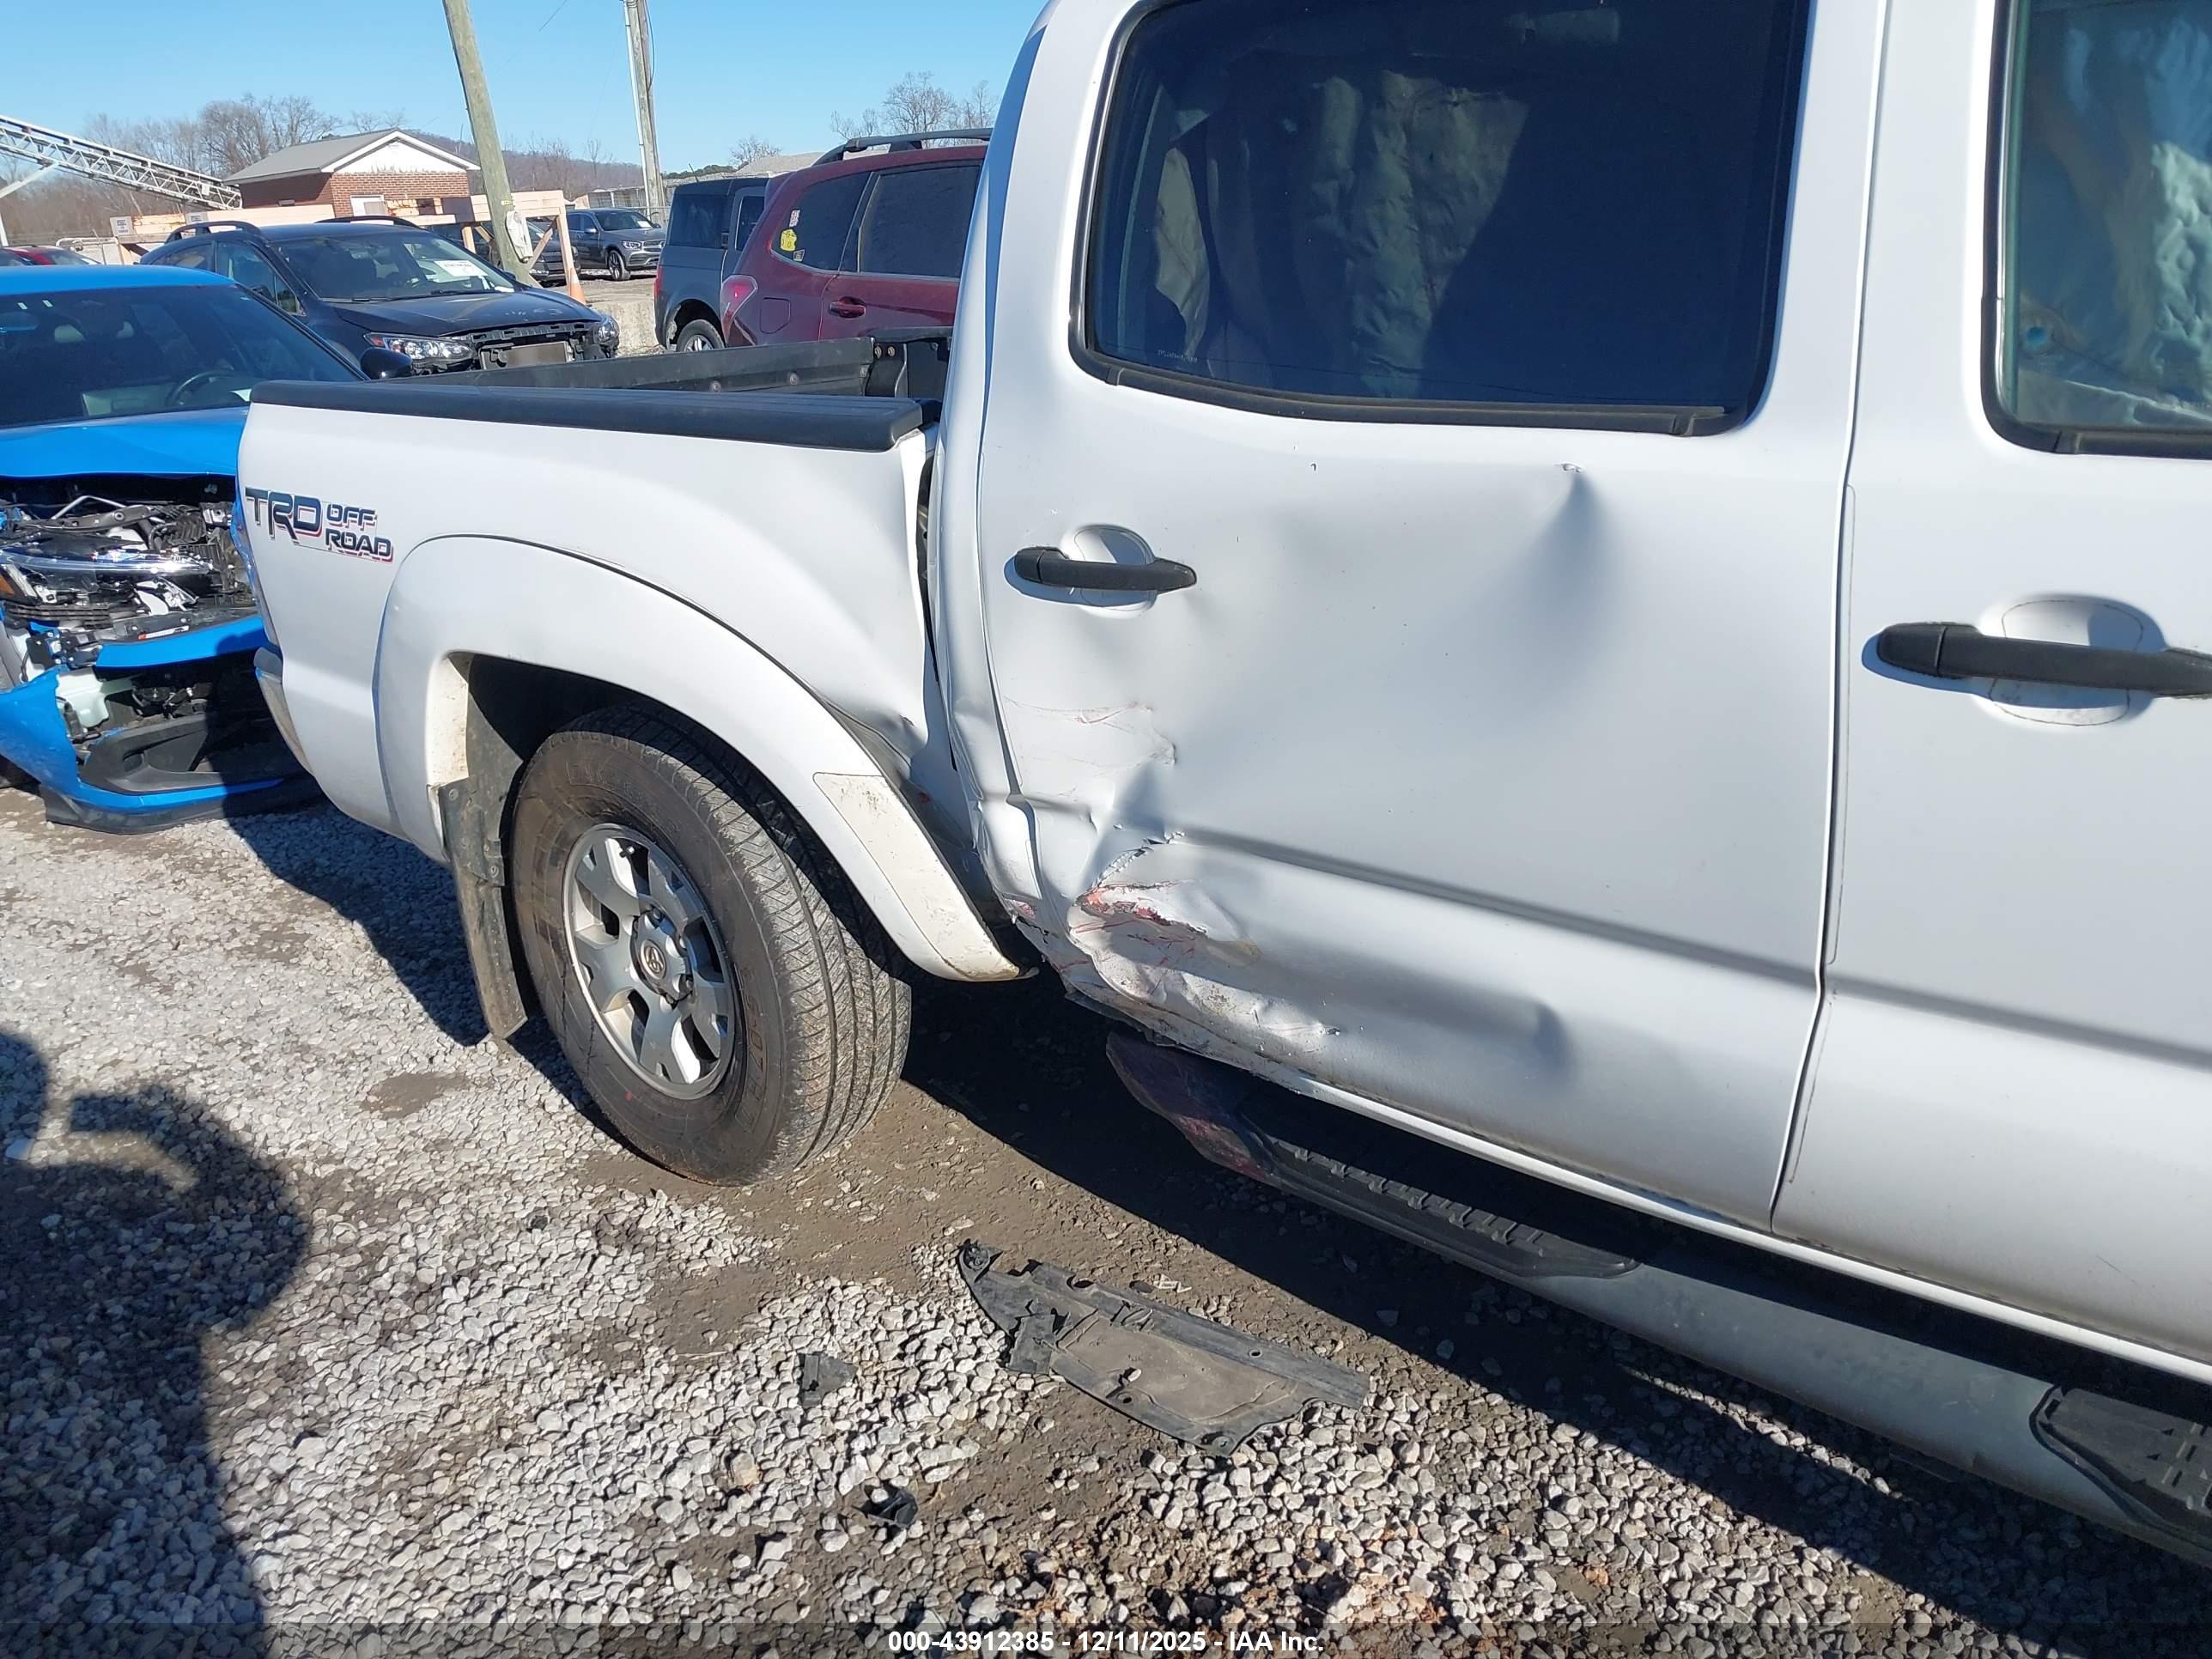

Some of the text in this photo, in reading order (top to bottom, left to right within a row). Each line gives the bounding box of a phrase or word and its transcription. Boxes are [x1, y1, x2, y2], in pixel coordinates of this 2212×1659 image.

[246, 487, 322, 544] TRD
[325, 503, 378, 532] OFF
[325, 528, 393, 562] ROAD
